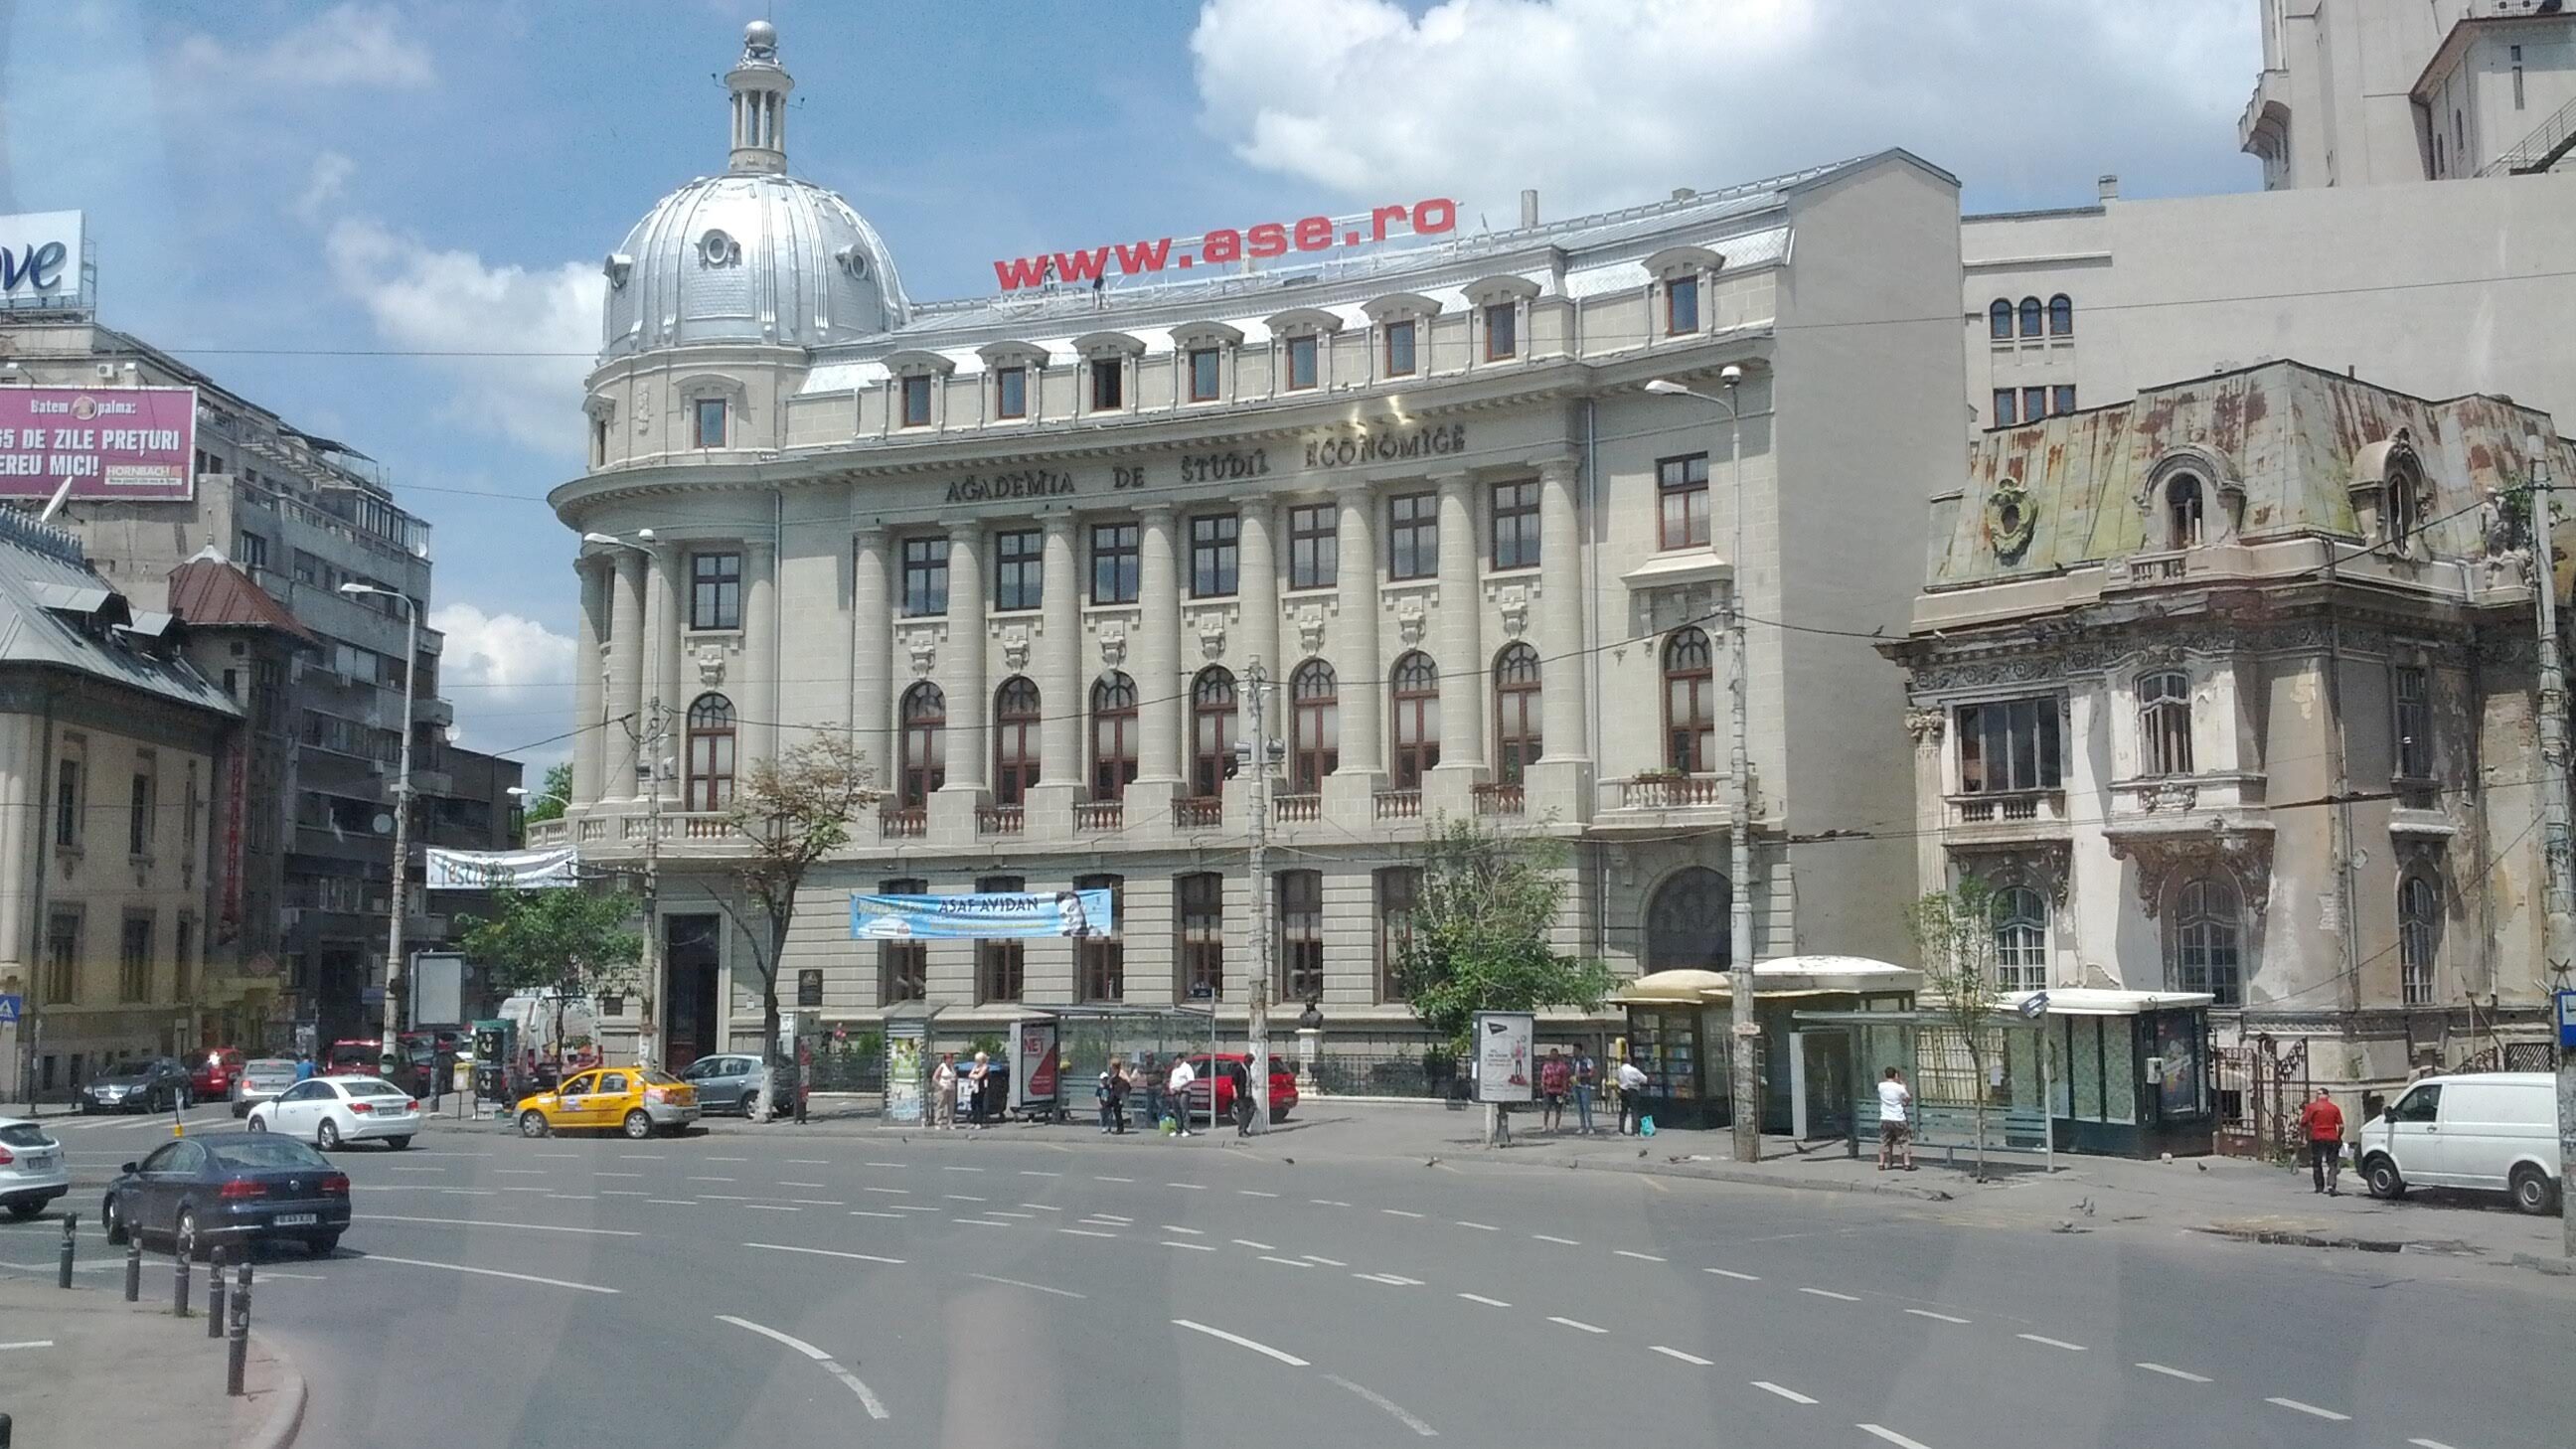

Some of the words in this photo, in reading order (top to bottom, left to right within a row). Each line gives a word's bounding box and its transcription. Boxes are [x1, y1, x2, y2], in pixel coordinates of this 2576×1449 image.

[993, 197, 1457, 291] www.ase.ro
[0, 241, 68, 291] ve
[31, 400, 69, 414] Batem
[98, 400, 136, 416] palma:
[22, 428, 46, 449] DE
[54, 428, 94, 450] ZILE
[50, 454, 99, 477] MICI!
[946, 470, 1076, 504] ACADEMIA
[1112, 465, 1145, 490] DE
[1304, 423, 1466, 469] ECONOMICE
[937, 897, 978, 914] ASAF
[979, 896, 1040, 913] AVIDAN
